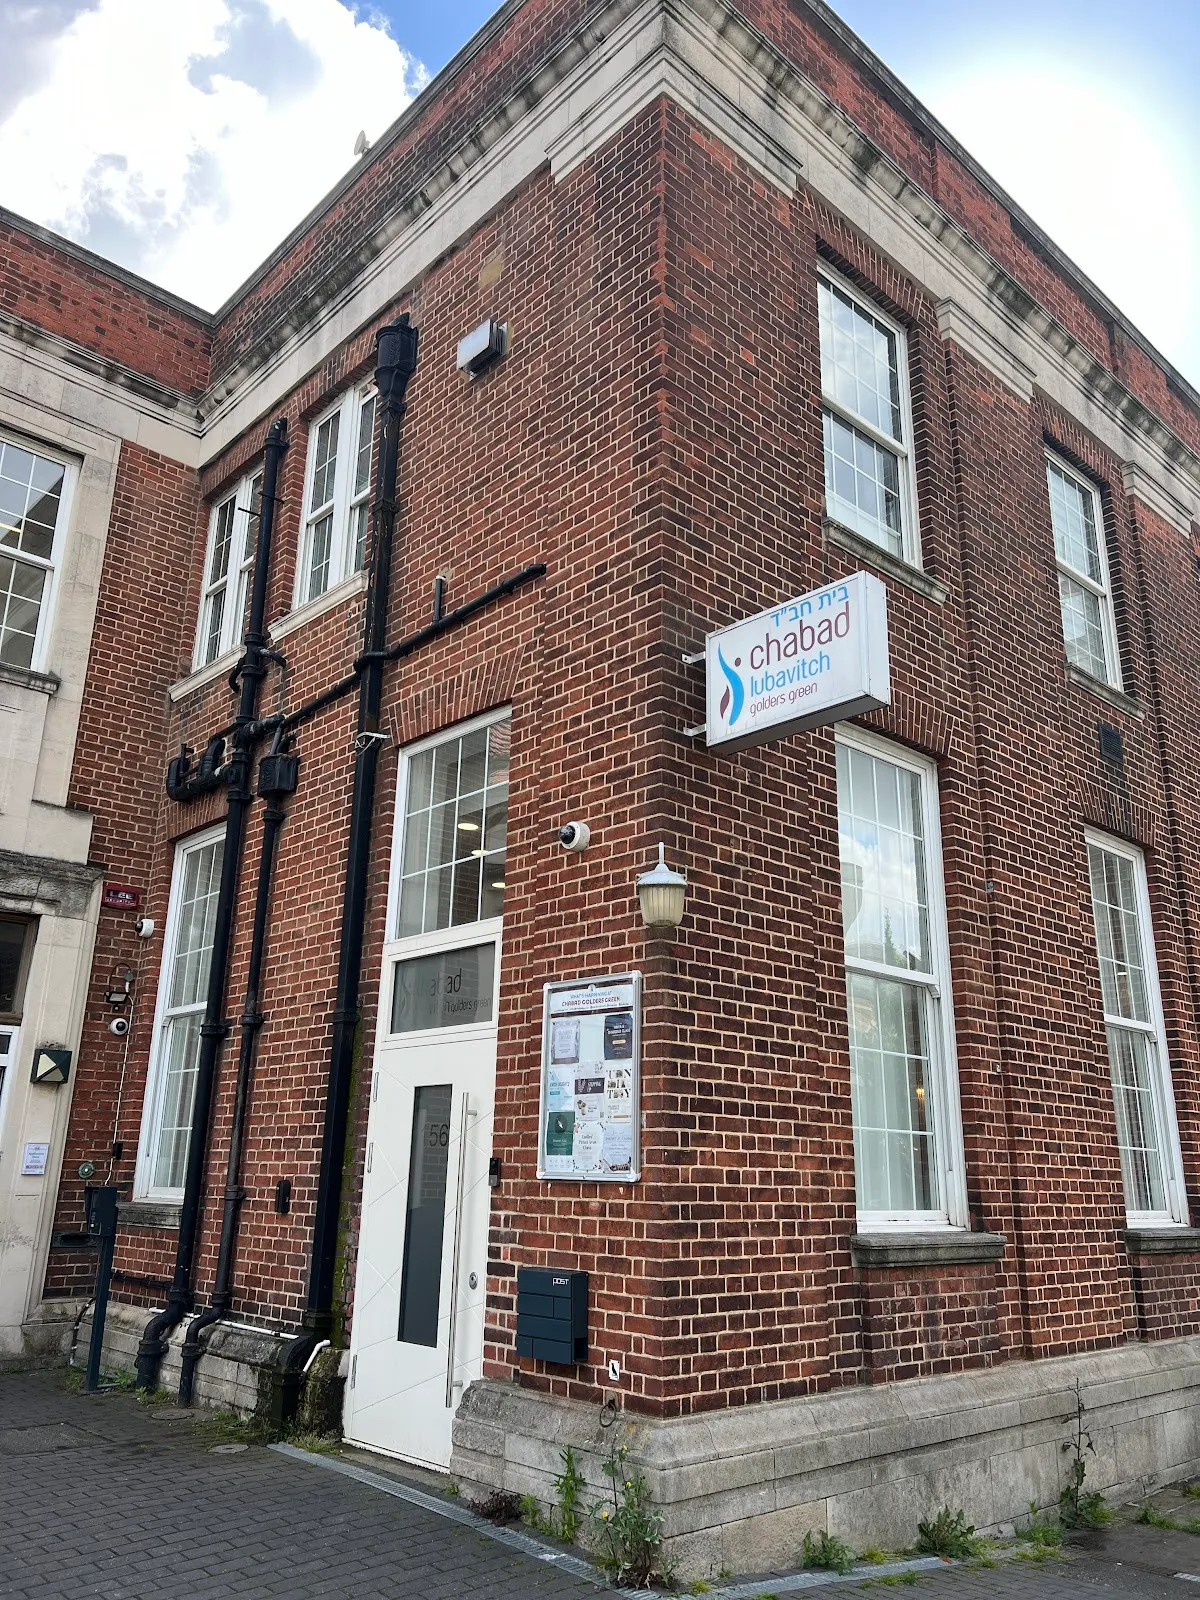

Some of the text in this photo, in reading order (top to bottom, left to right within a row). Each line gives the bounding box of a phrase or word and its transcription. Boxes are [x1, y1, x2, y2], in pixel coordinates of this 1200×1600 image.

[818, 586, 849, 611] בית
[750, 601, 850, 670] chabad
[750, 651, 831, 697] lubavitch
[750, 682, 818, 717] golders green
[430, 1124, 449, 1147] 56
